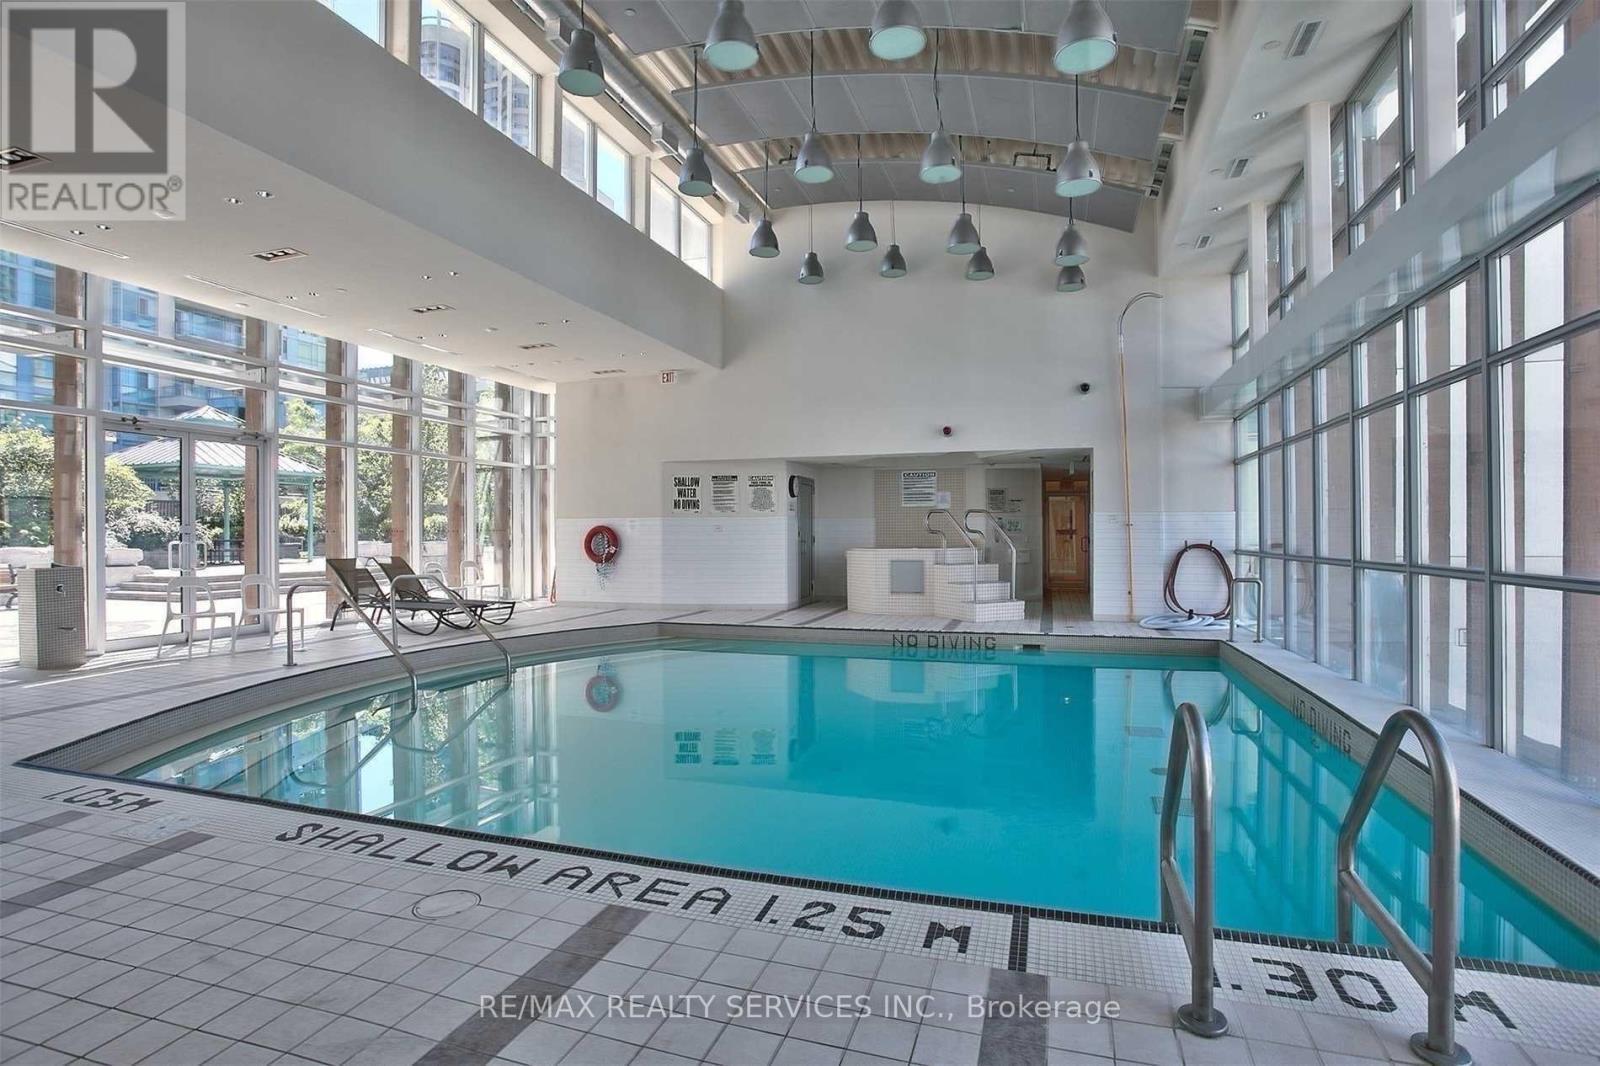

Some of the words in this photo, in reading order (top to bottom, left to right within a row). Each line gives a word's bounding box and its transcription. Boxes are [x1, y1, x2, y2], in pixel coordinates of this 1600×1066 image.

[662, 371, 675, 384] EXIT
[673, 476, 700, 488] SHALLOW
[676, 488, 697, 498] WATER
[673, 499, 681, 510] NO
[682, 499, 700, 510] DIVING
[892, 634, 918, 649] NO
[927, 635, 996, 650] DIVING
[275, 822, 541, 880] SHALLOW
[542, 865, 733, 915] AREA
[754, 894, 892, 940] 1.25
[922, 921, 972, 954] M
